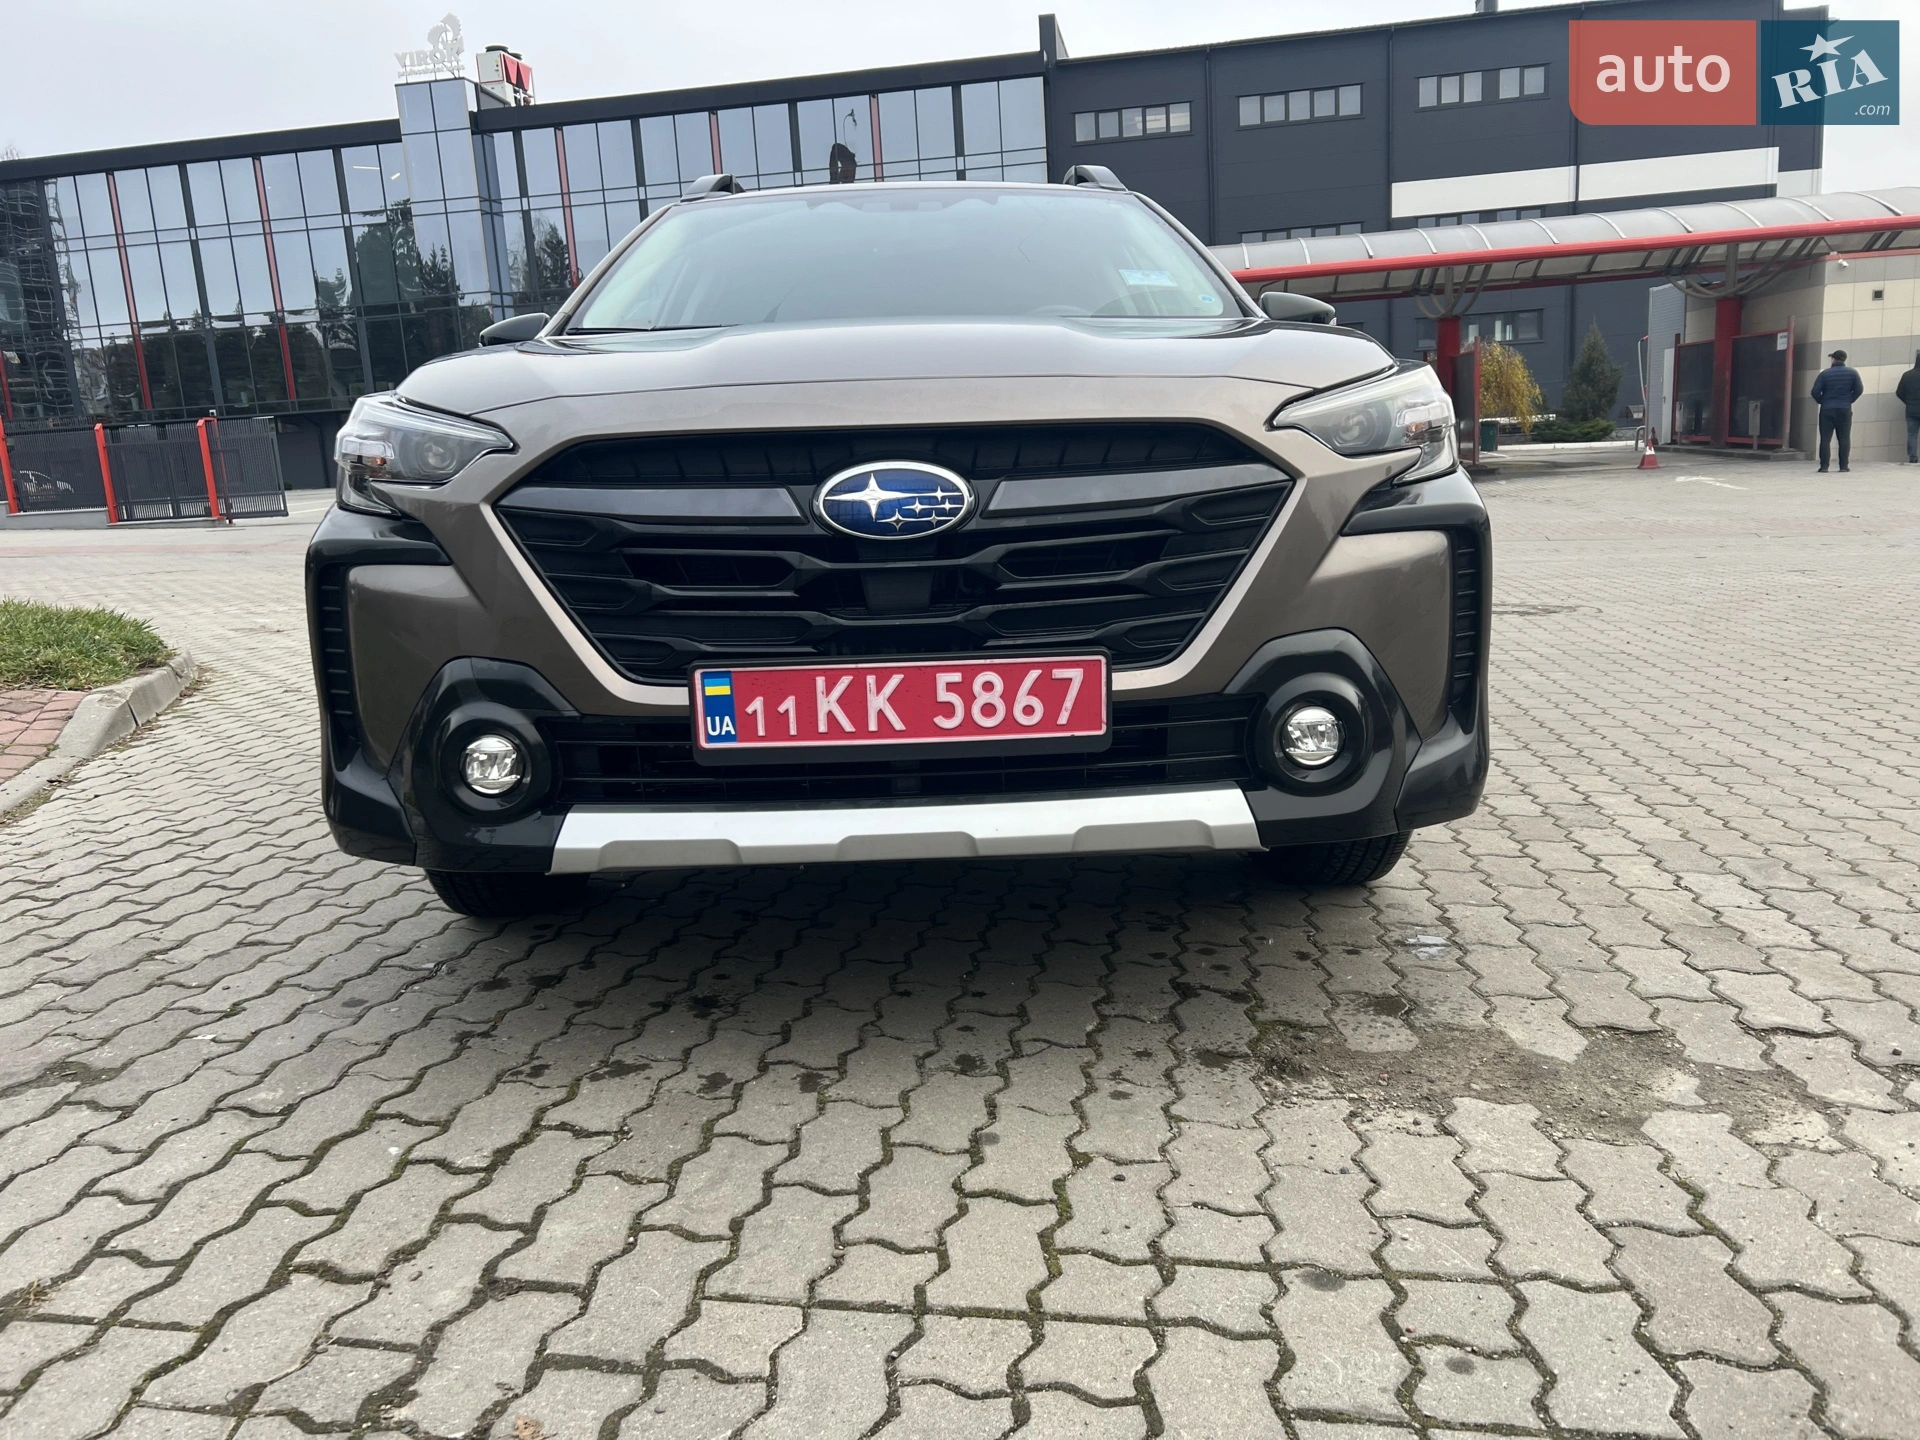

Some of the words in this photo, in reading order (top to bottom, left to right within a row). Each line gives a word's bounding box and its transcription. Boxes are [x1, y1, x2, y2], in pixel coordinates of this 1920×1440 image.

[394, 47, 460, 67] VIROK
[745, 695, 797, 737] 11
[815, 674, 906, 733] KK
[933, 668, 1084, 730] 5867
[706, 716, 736, 737] UA
